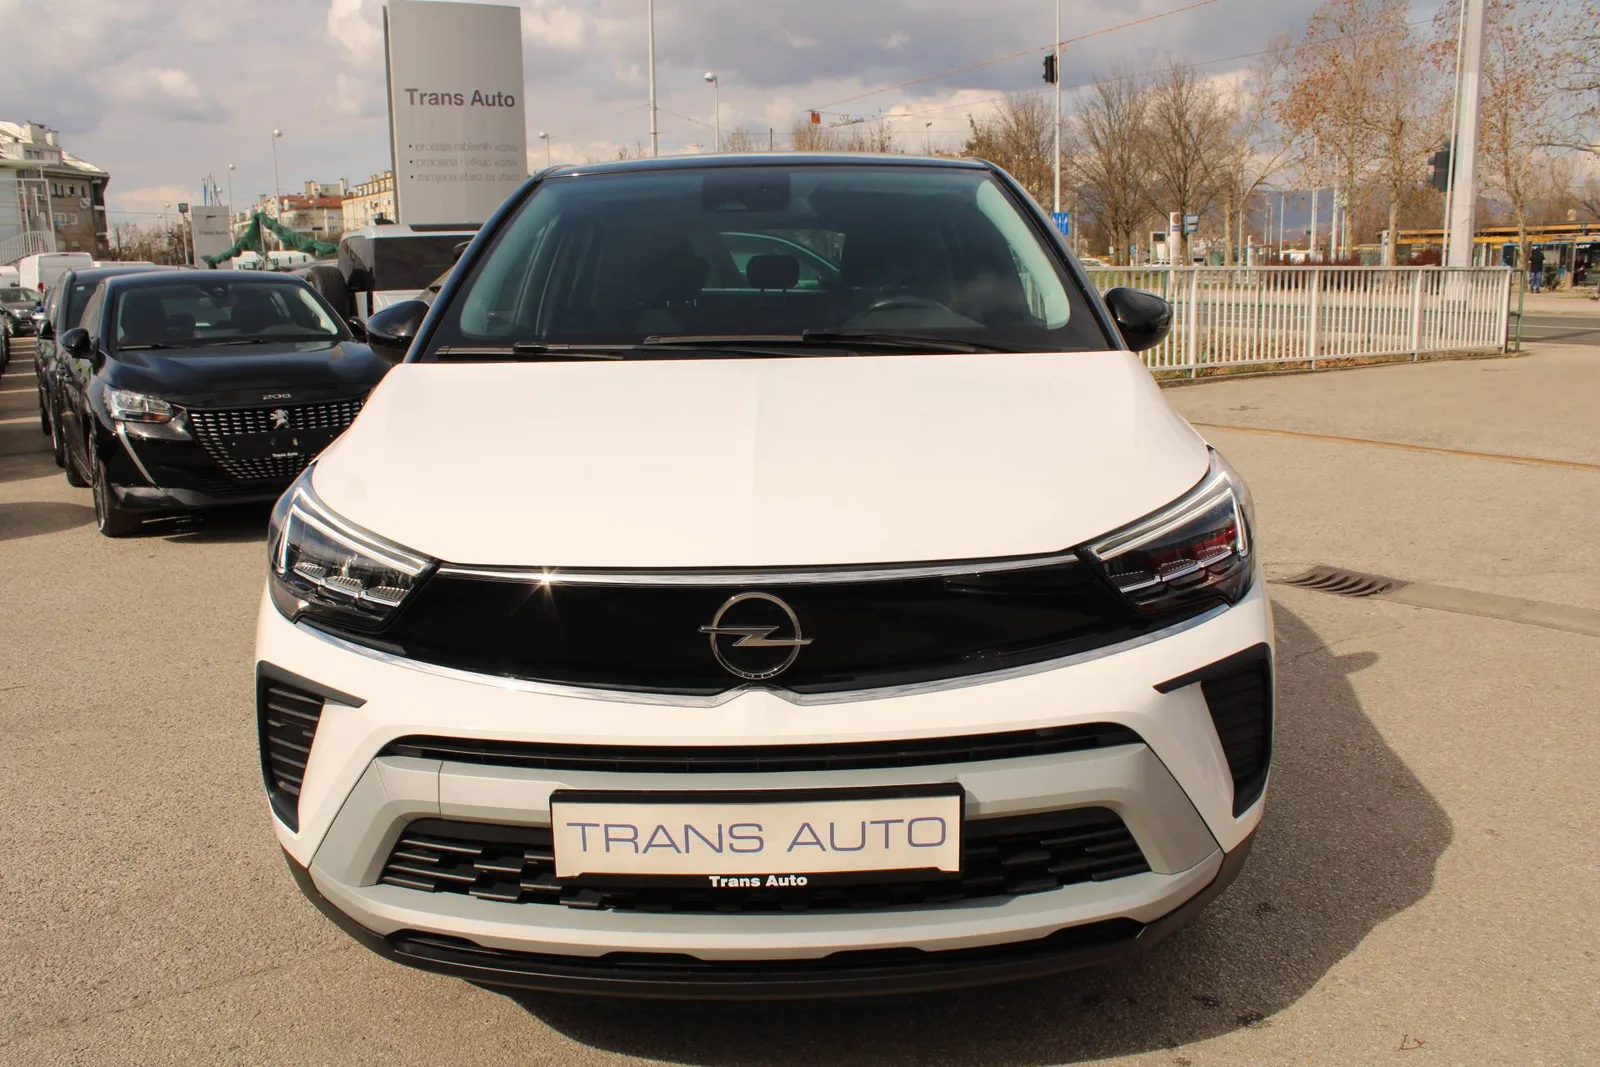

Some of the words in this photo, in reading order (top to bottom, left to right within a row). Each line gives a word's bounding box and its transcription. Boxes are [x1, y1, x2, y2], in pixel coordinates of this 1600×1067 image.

[404, 88, 464, 106] Trans
[470, 89, 516, 108] Auto
[566, 822, 765, 854] TRANS
[786, 816, 947, 853] AUTO
[708, 875, 761, 888] Trans
[765, 874, 808, 887] Auto
